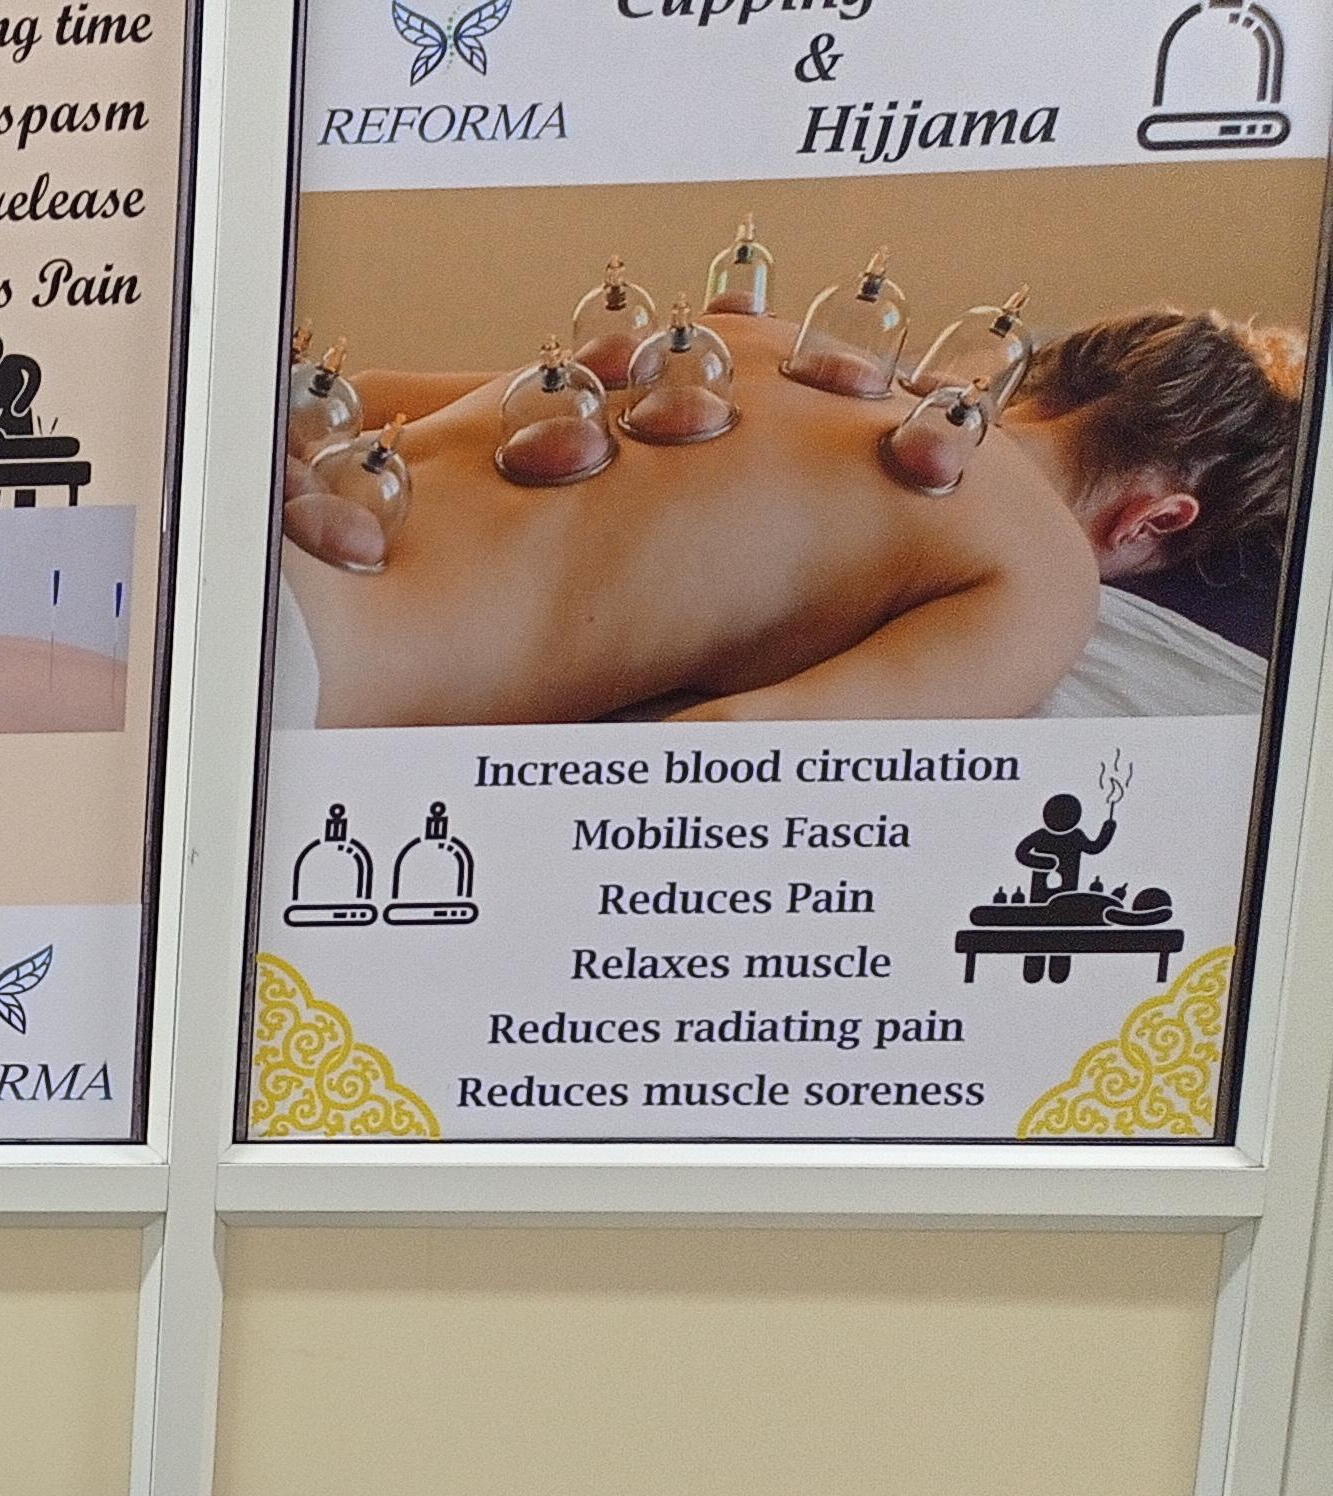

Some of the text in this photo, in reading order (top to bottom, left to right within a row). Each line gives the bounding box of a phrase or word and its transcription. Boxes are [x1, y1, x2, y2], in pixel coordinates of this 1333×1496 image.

[56, 4, 152, 45] time
[795, 33, 843, 83] &
[318, 102, 566, 145] REFORMA
[797, 100, 1059, 163] Hijjama
[32, 259, 141, 307] Pain
[475, 748, 1019, 786] Increase blood circulation
[573, 815, 909, 850] Mobilises Fascia
[599, 881, 874, 914] Reduces Pain
[572, 946, 890, 979] Relaxes muscle
[489, 1010, 964, 1050] Reduces radiating pain
[458, 1074, 984, 1107] Reduces muscle soreness
